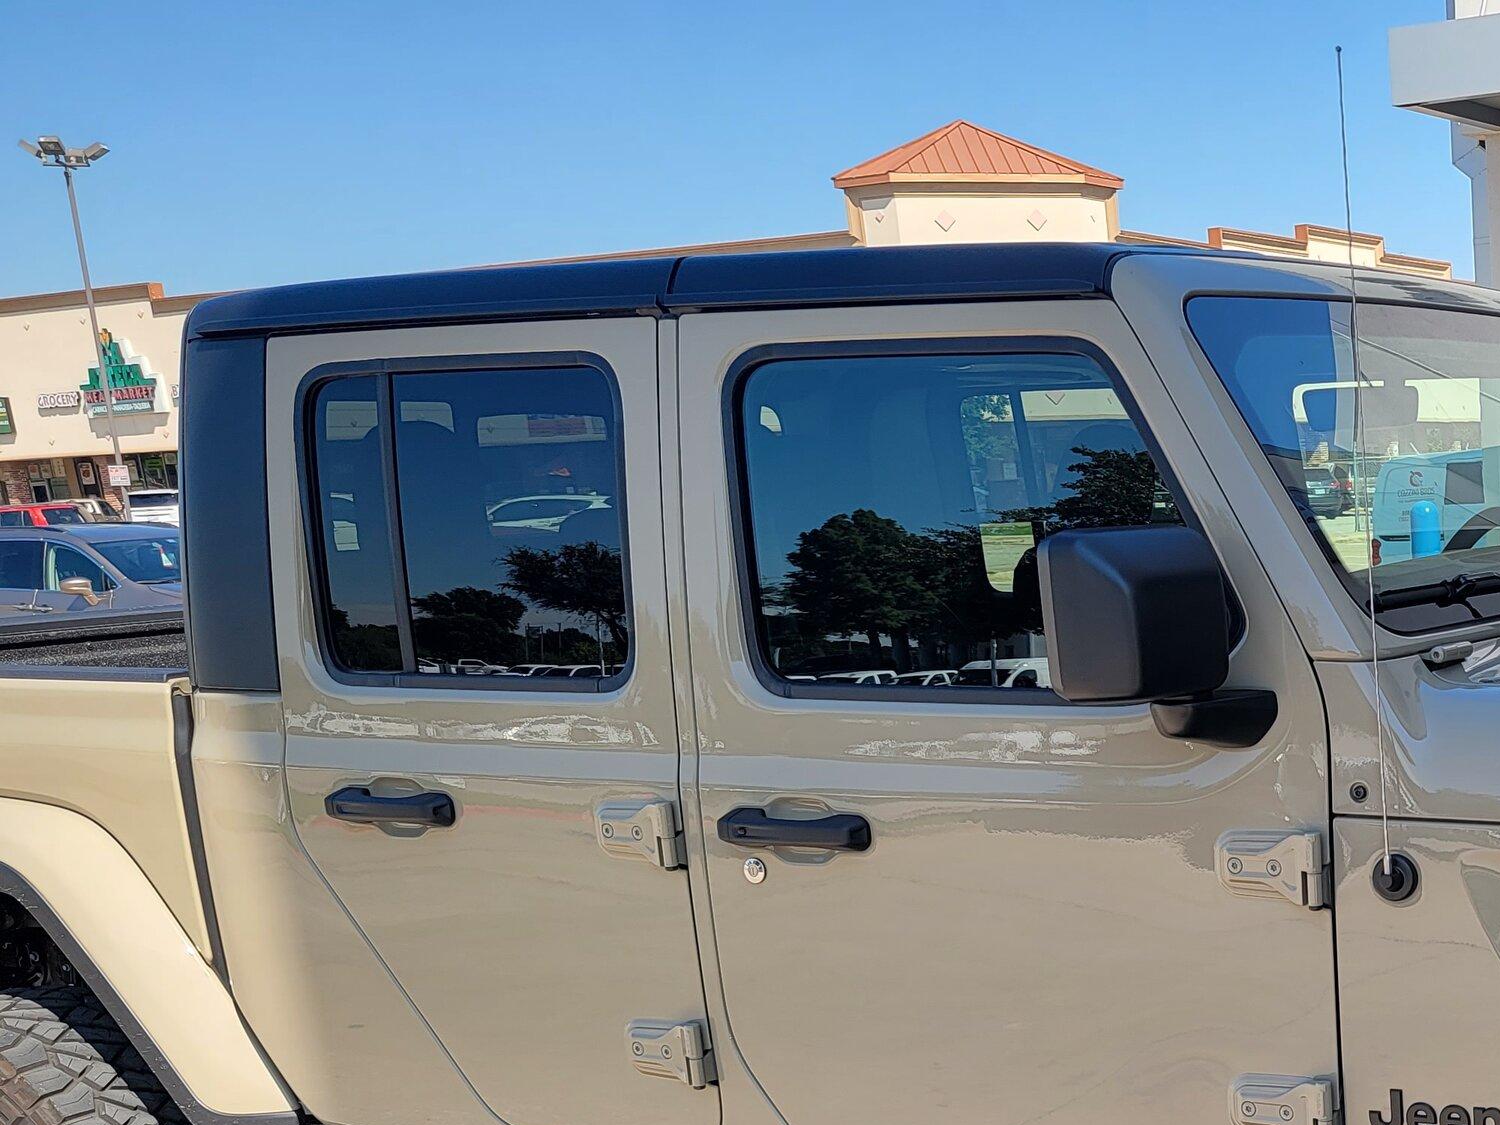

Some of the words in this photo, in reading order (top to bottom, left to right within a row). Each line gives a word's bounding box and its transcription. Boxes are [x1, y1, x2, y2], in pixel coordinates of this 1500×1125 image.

[38, 391, 79, 407] GROCERY
[85, 390, 107, 404] MEA
[114, 386, 154, 401] MARKET
